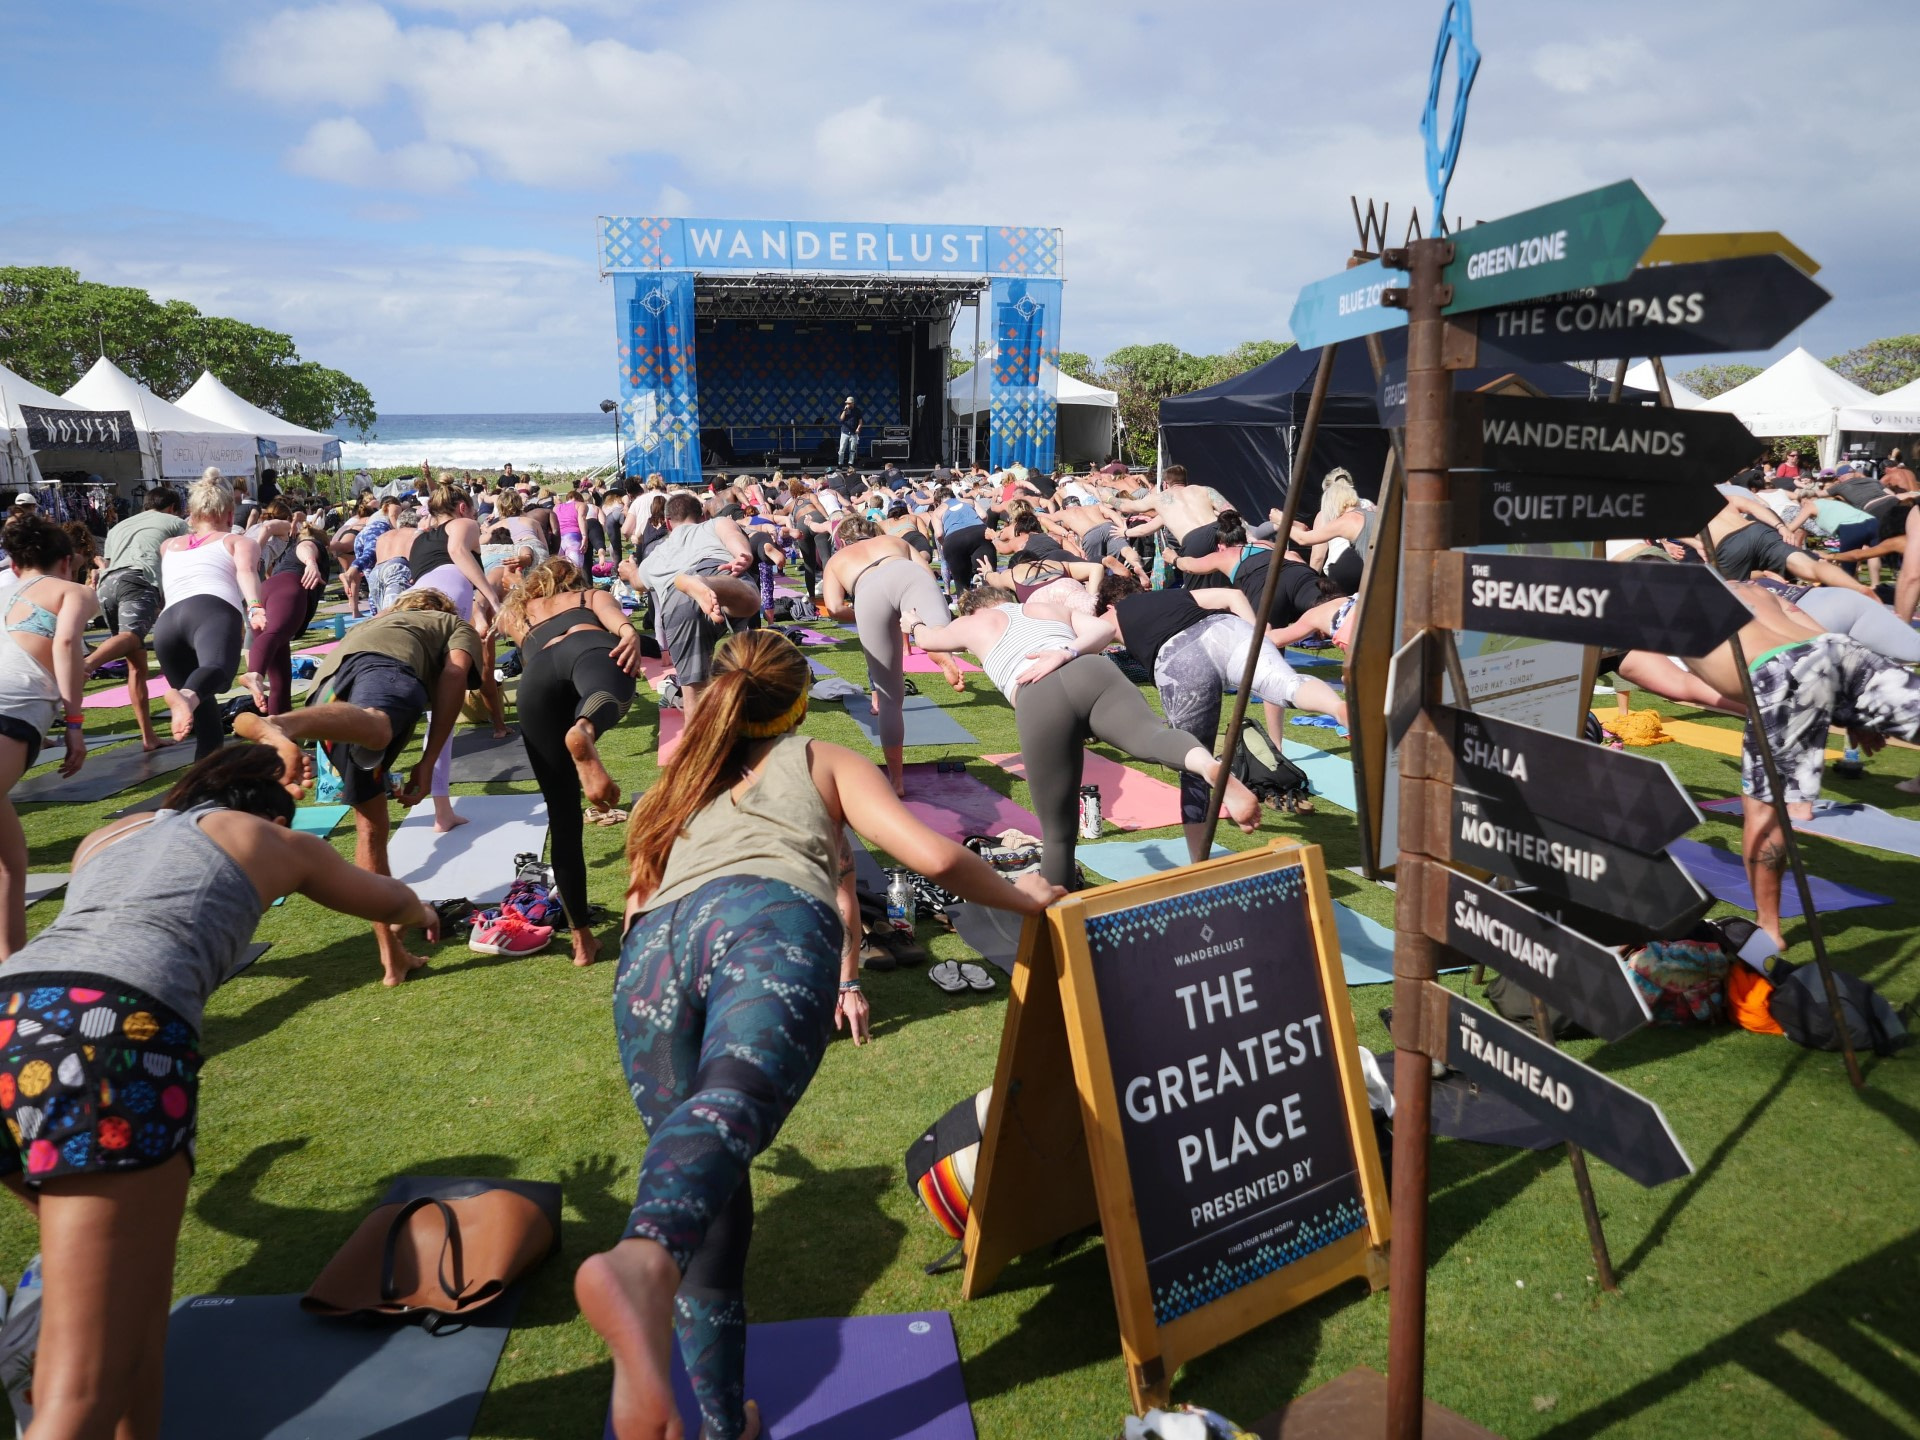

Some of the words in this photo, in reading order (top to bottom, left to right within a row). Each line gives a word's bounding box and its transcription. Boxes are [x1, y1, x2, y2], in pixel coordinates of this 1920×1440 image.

[690, 228, 982, 263] WANDERLUST
[1467, 245, 1516, 280] GREEN
[1518, 230, 1568, 268] ZONE
[1339, 289, 1365, 316] BLUE
[1496, 309, 1545, 337] THE
[1556, 293, 1705, 333] COMPASS
[39, 414, 120, 443] WOLVEN
[1483, 419, 1686, 456] WANDERLANDS
[173, 448, 194, 462] OPEN
[1493, 482, 1512, 493] THE
[1493, 495, 1567, 526] QUIET
[1572, 494, 1646, 519] PLACE
[1472, 564, 1490, 577] THE
[1472, 579, 1610, 618] SPEAKEASY
[1471, 682, 1488, 693] YOUR
[1490, 680, 1504, 690] WAY
[1509, 673, 1534, 686] SUNDAY
[1464, 723, 1479, 737] THE
[1463, 738, 1529, 782] SHALA
[1462, 801, 1479, 816] THE
[1461, 816, 1608, 882] MOTHERSHIP
[1464, 889, 1479, 906] THE
[1174, 937, 1245, 967] WANDERLUST
[1454, 900, 1559, 979] SANCTUARY
[1175, 967, 1259, 1030] THE
[1461, 1012, 1477, 1030] THE
[1125, 1014, 1322, 1123] GREATEST
[1460, 1025, 1575, 1112] TRAILHEAD
[1178, 1092, 1307, 1184] PLACE
[1190, 1169, 1289, 1228] PRESENTED
[1293, 1157, 1313, 1183] BY
[1228, 1242, 1243, 1256] FIND
[1242, 1235, 1260, 1249] YOUR
[1259, 1228, 1274, 1243] TRUE
[1273, 1219, 1294, 1236] NORTH
